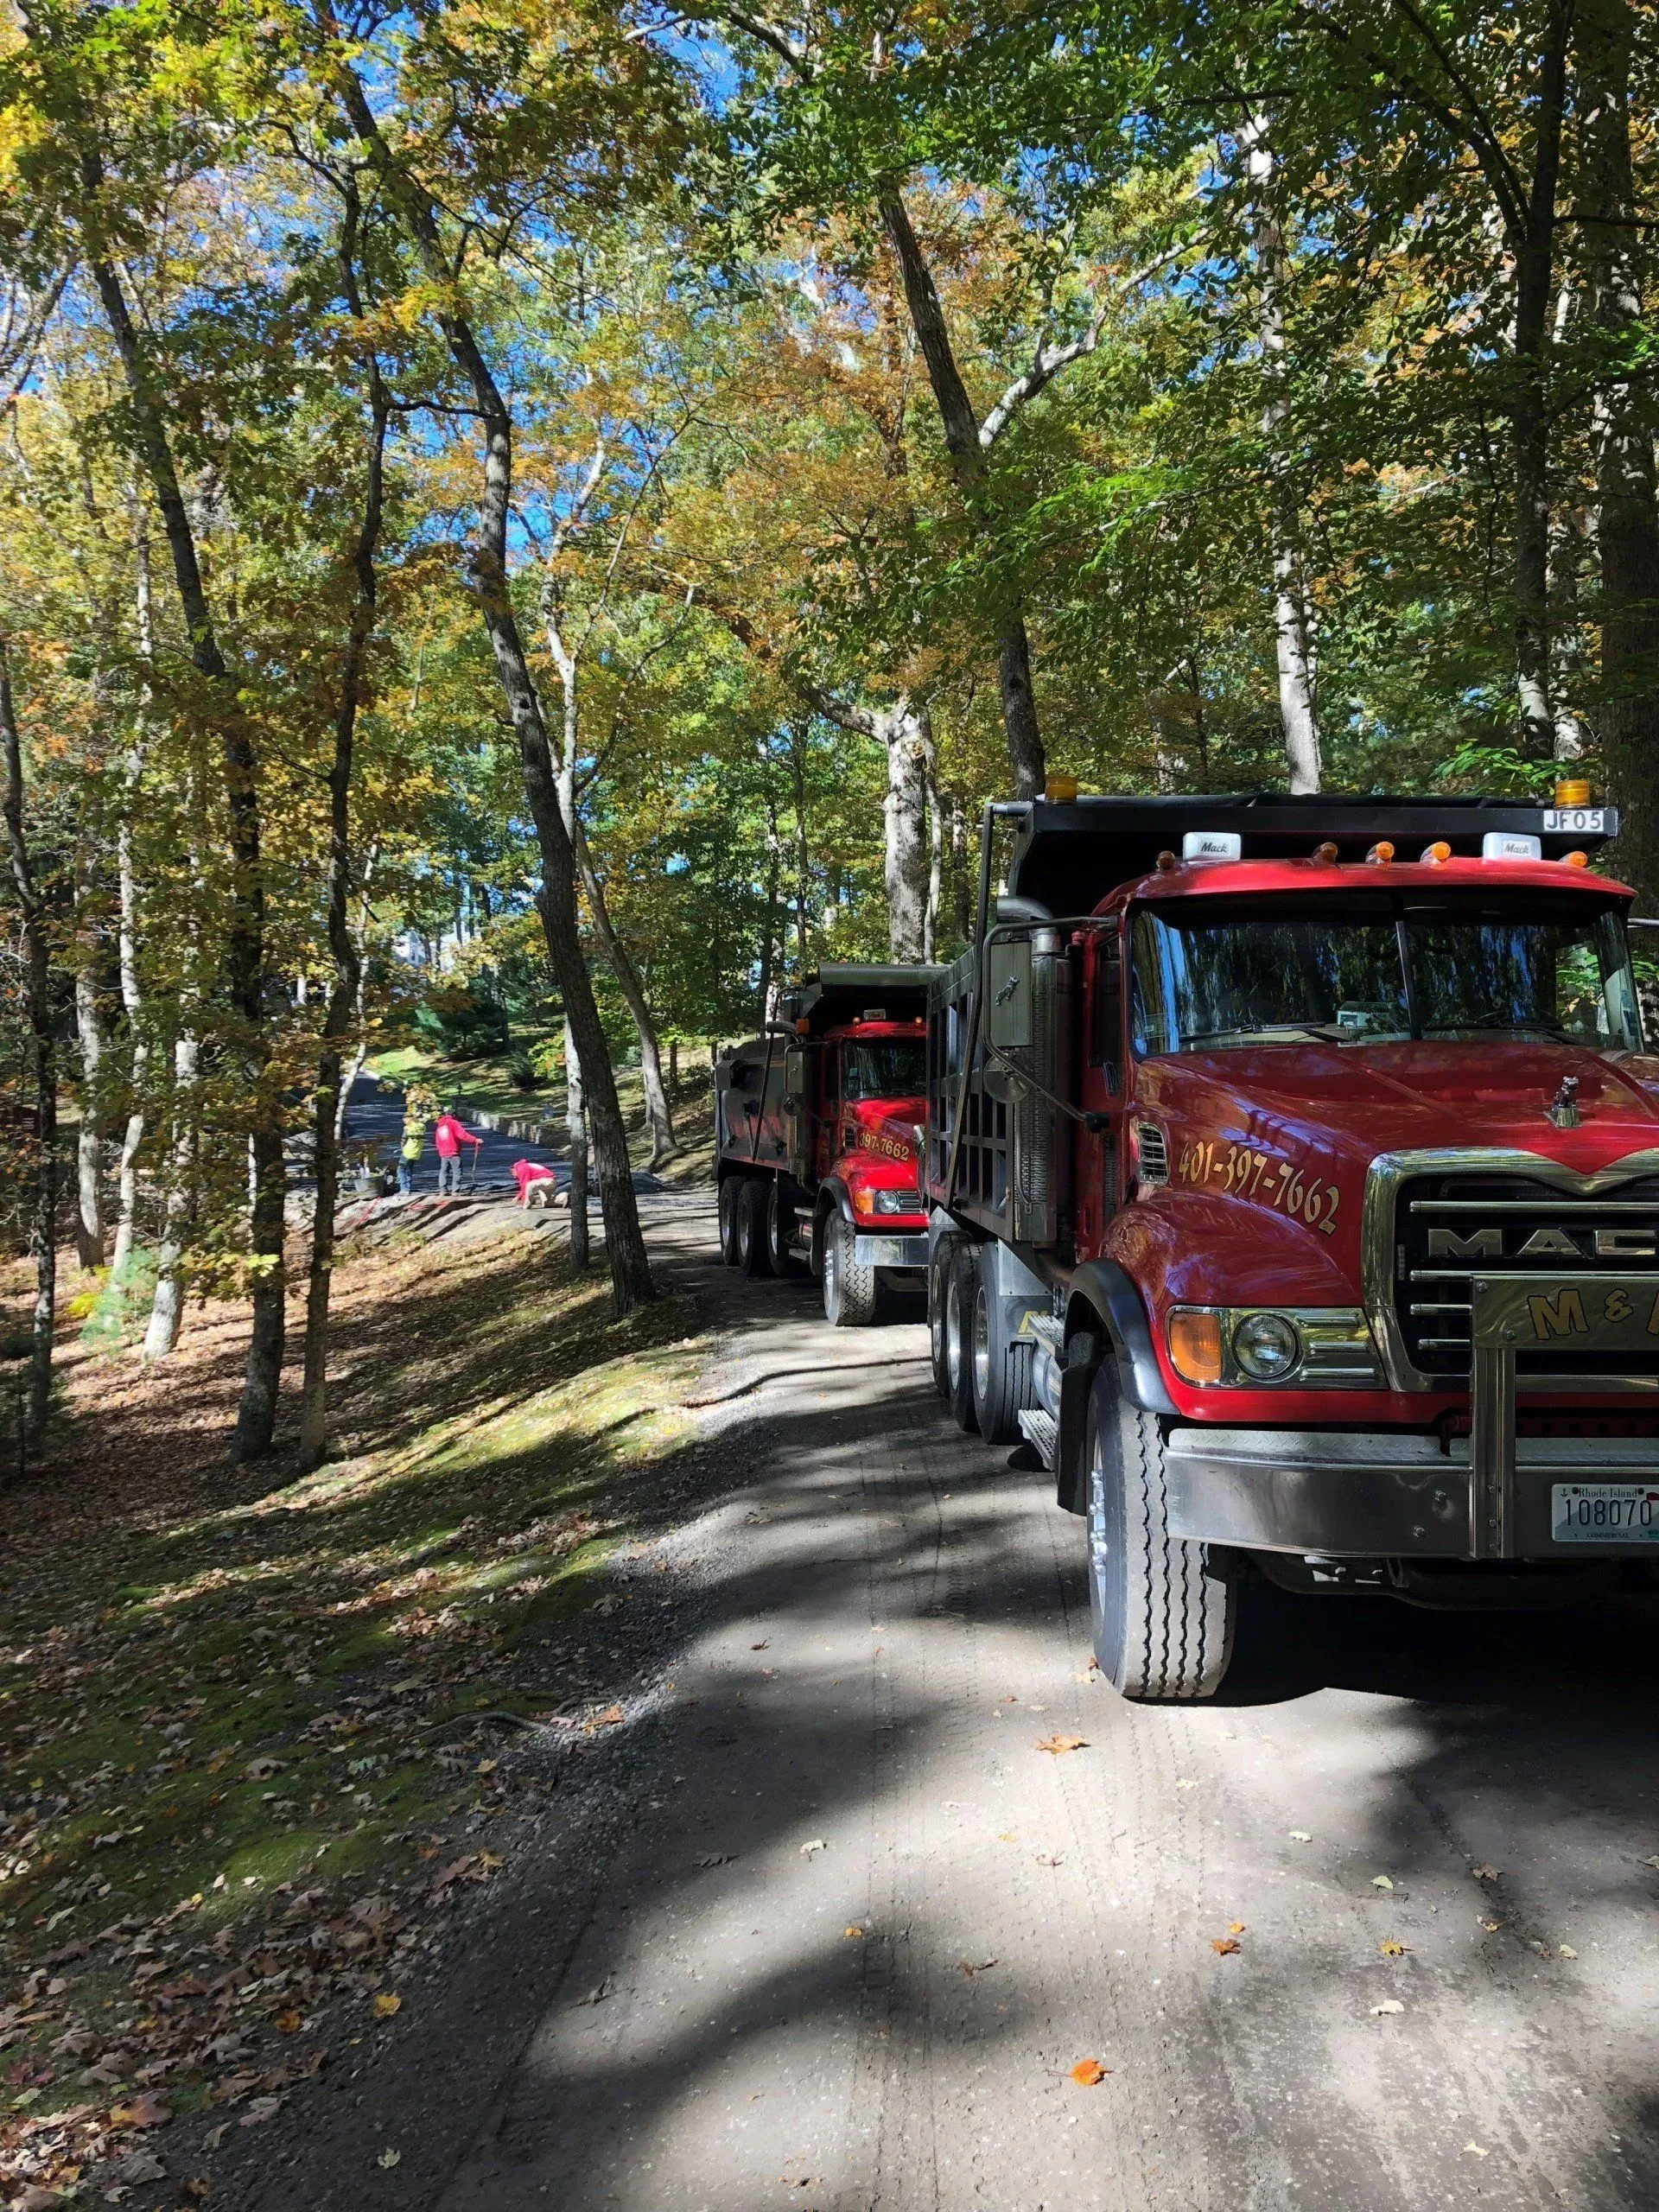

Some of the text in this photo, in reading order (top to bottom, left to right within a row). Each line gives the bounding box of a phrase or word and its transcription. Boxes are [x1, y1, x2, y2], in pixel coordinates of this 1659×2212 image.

[1547, 810, 1601, 830] JF05
[1200, 842, 1228, 853] Mack
[1503, 842, 1529, 855] Mack
[1179, 1141, 1340, 1236] 401-397-7662
[1527, 1288, 1590, 1340] M
[1603, 1288, 1634, 1323] &
[1578, 1488, 1637, 1498] Rhode Island
[1565, 1498, 1652, 1527] 108070
